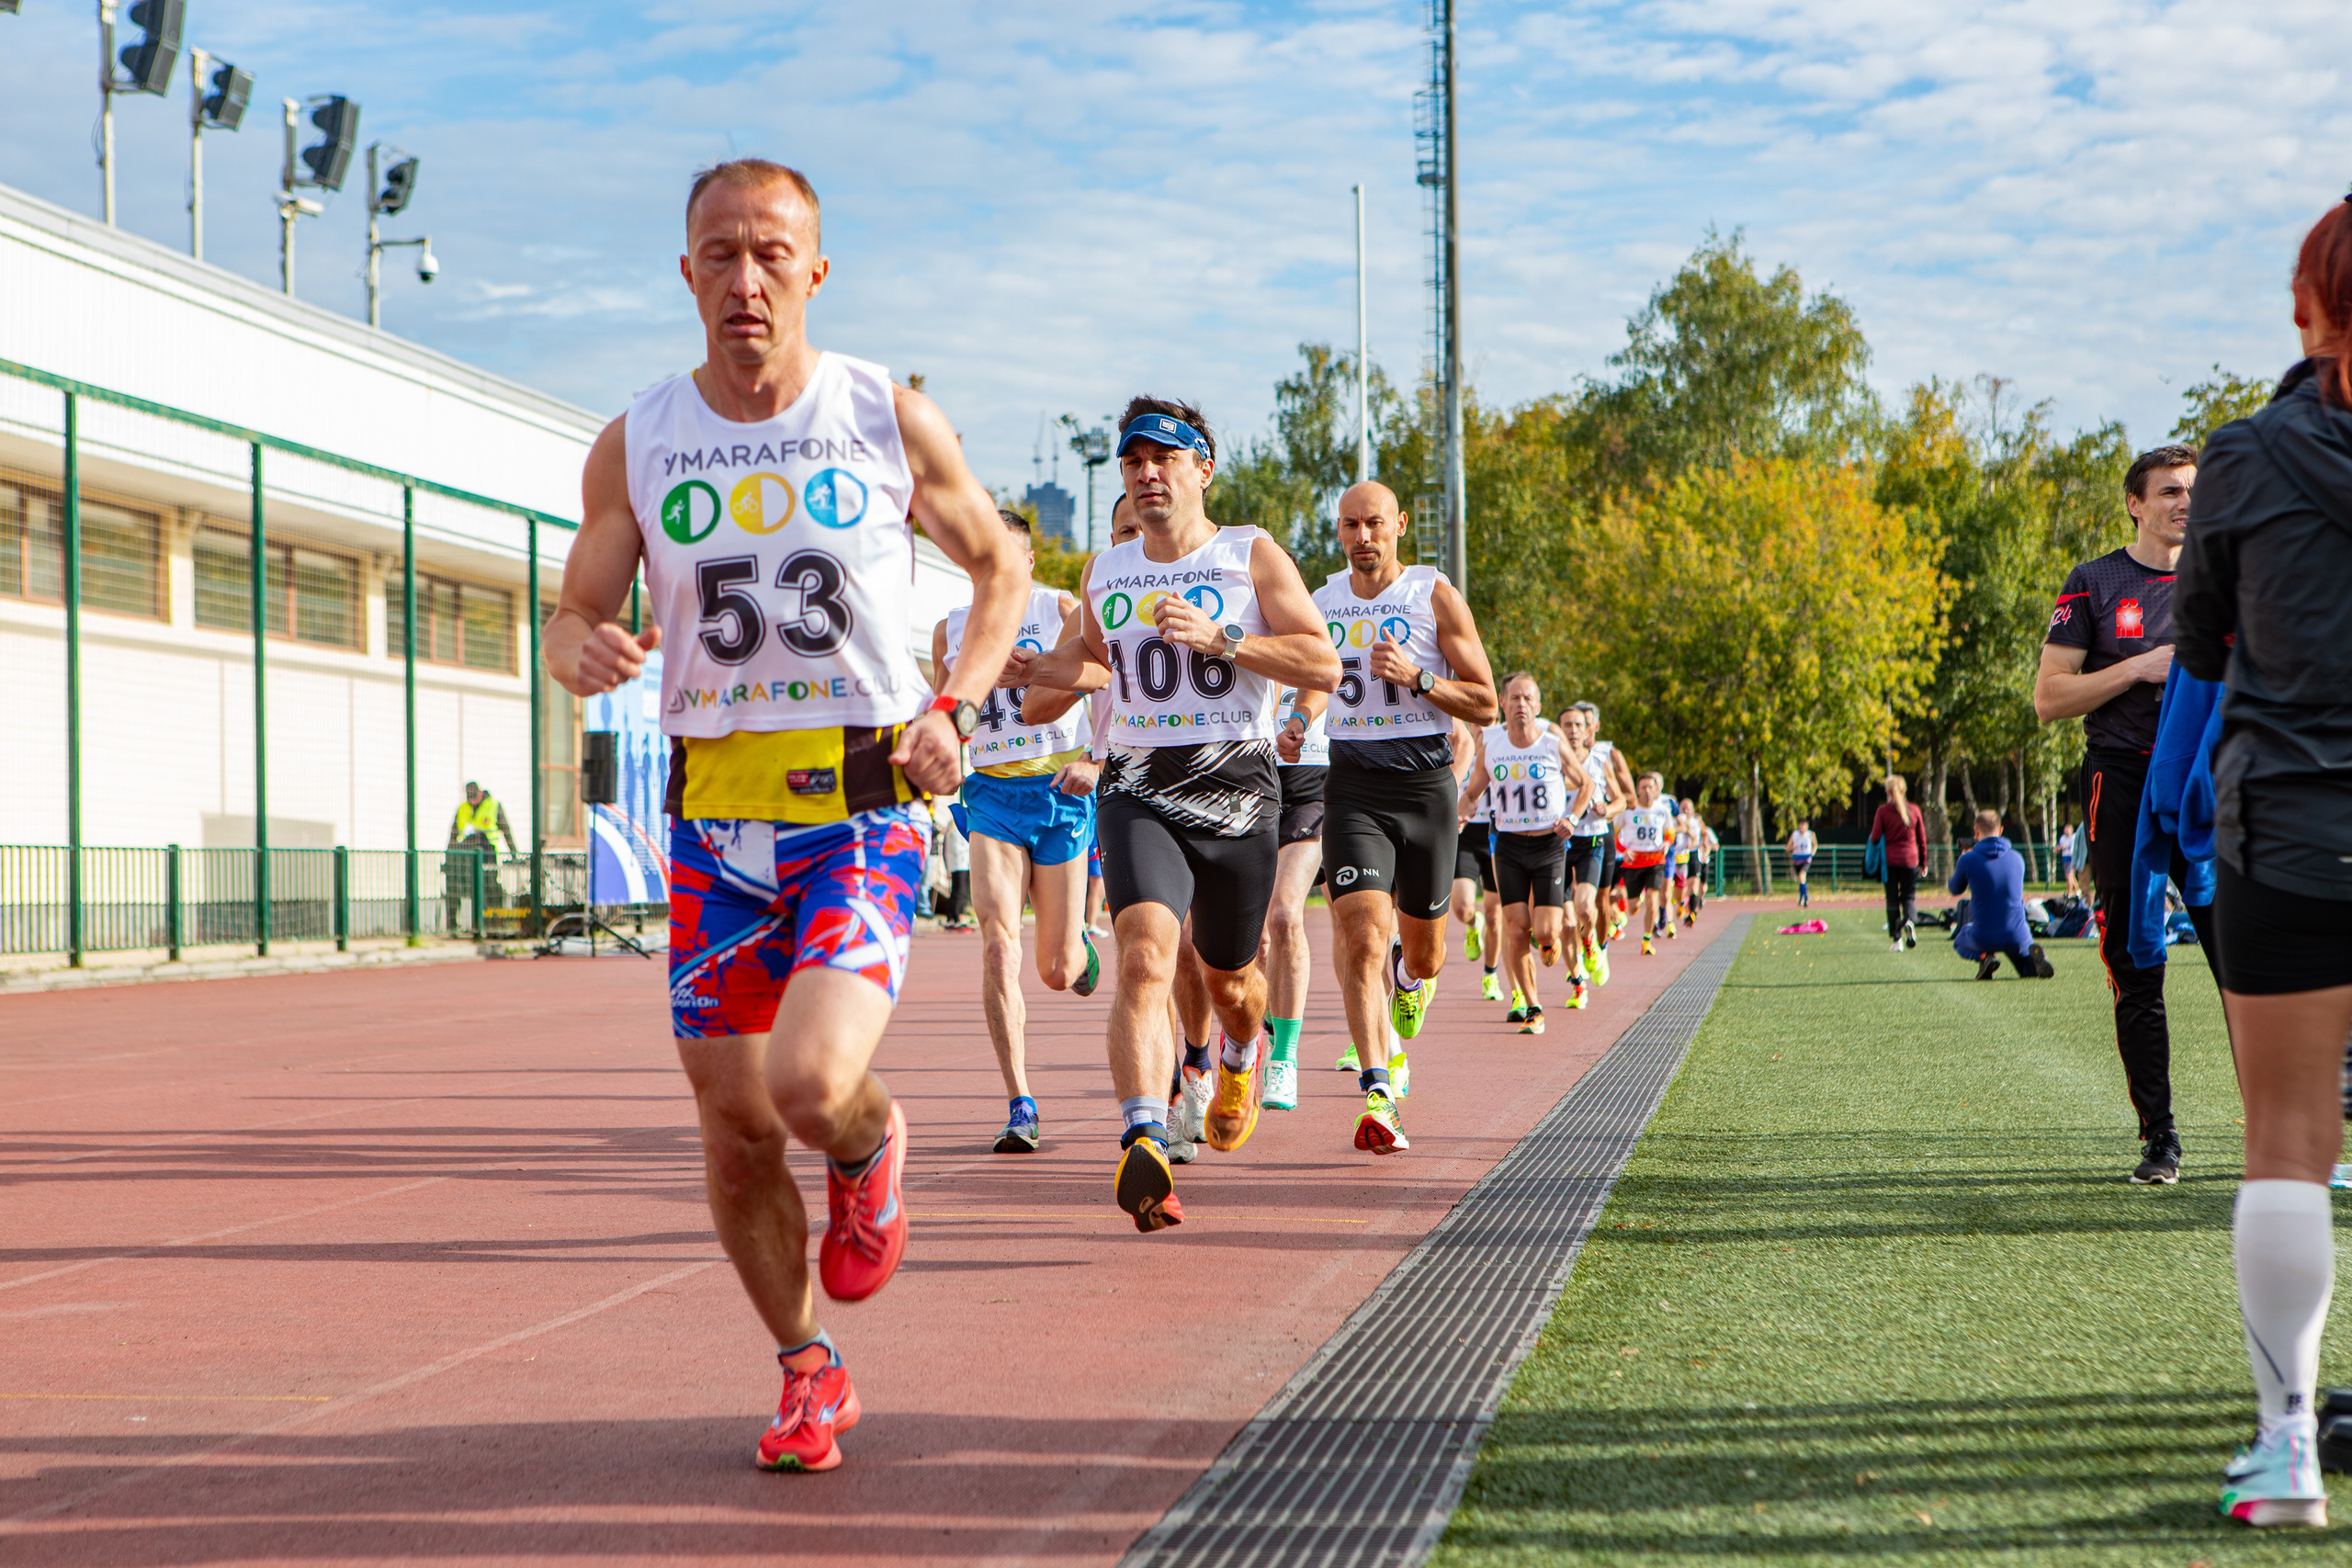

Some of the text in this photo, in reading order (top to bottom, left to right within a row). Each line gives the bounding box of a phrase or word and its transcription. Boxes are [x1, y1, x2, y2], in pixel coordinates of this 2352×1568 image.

[696, 548, 854, 667] 53
[1324, 604, 1412, 619] VMARAFONE
[1108, 637, 1237, 704] 106
[1496, 784, 1550, 813] 118
[1363, 868, 1380, 877] NN
